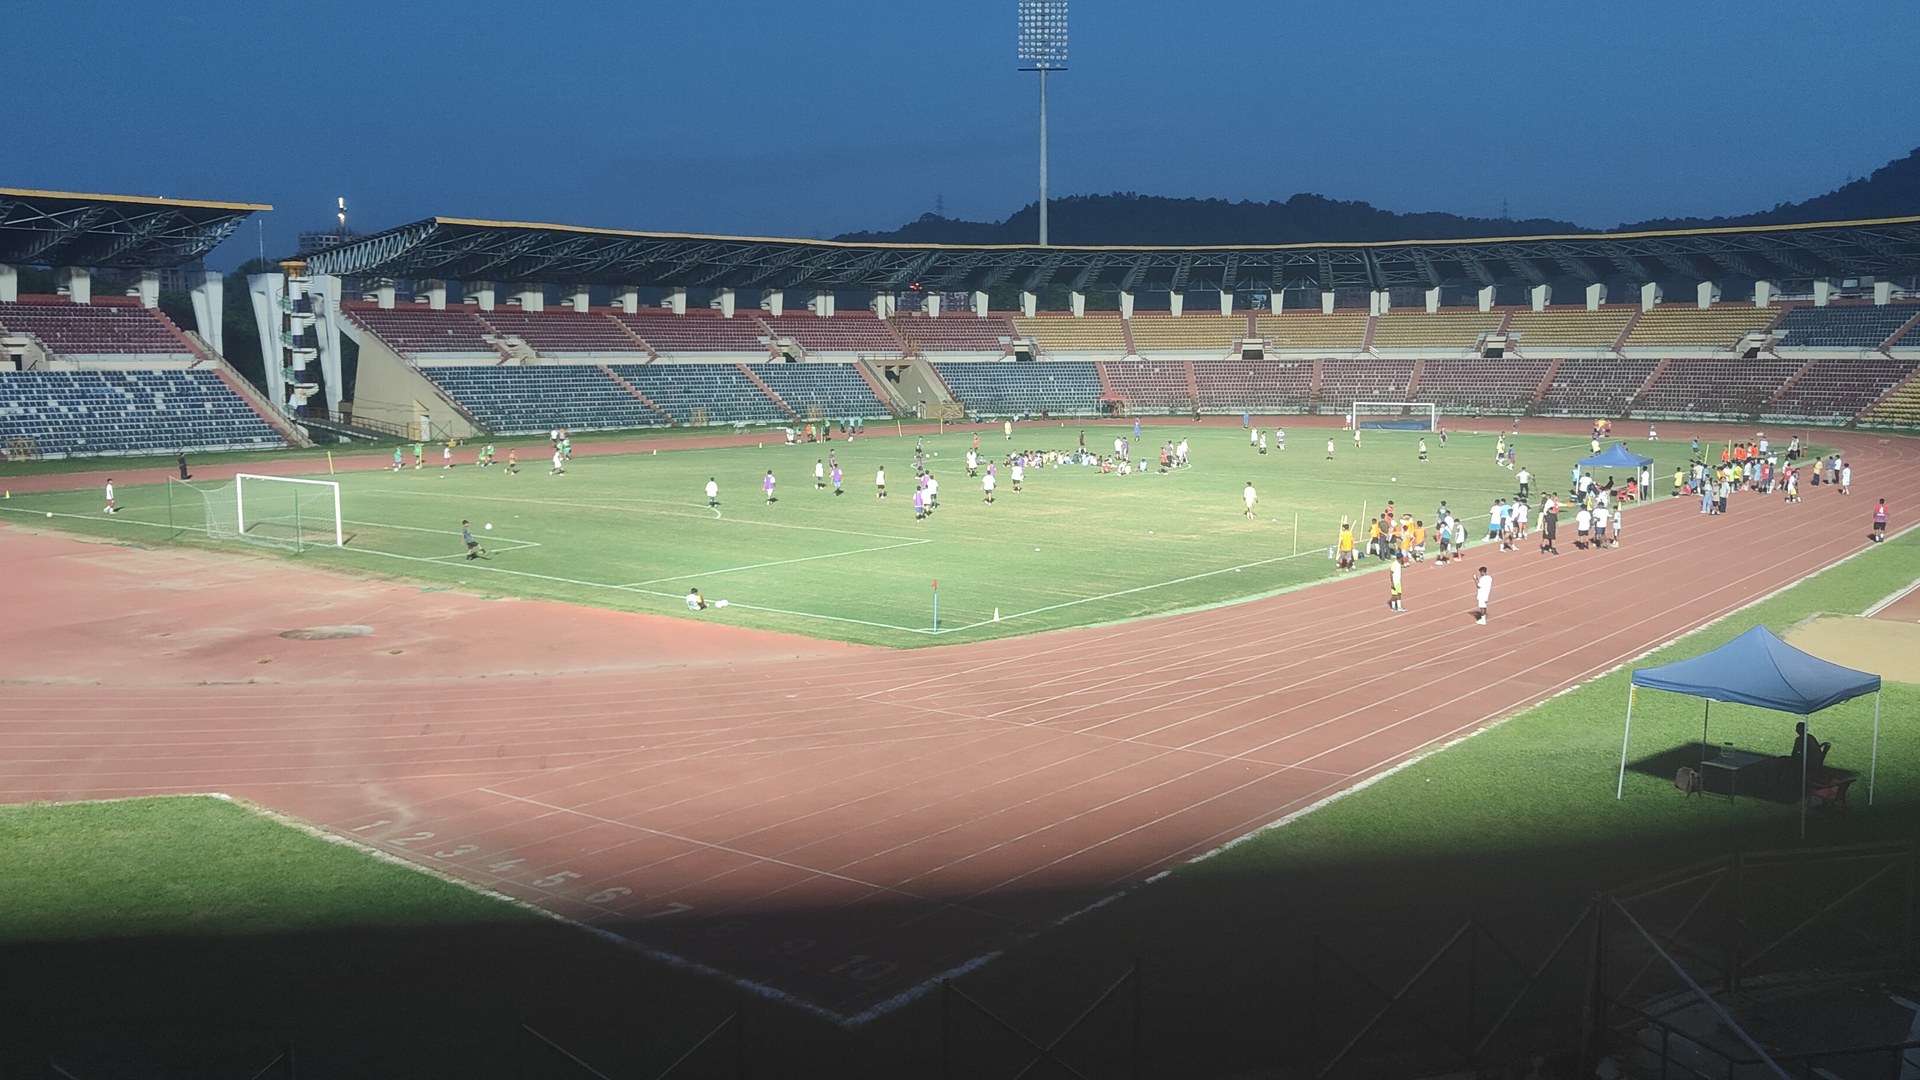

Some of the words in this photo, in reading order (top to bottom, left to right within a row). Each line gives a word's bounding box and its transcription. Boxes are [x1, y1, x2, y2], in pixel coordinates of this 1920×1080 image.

[352, 820, 393, 832] 1
[387, 831, 435, 846] 2
[434, 844, 479, 858] 3
[487, 858, 527, 873] 4
[532, 871, 583, 887] 5
[585, 887, 632, 903] 6
[641, 901, 694, 919] 7
[828, 954, 899, 981] 10
